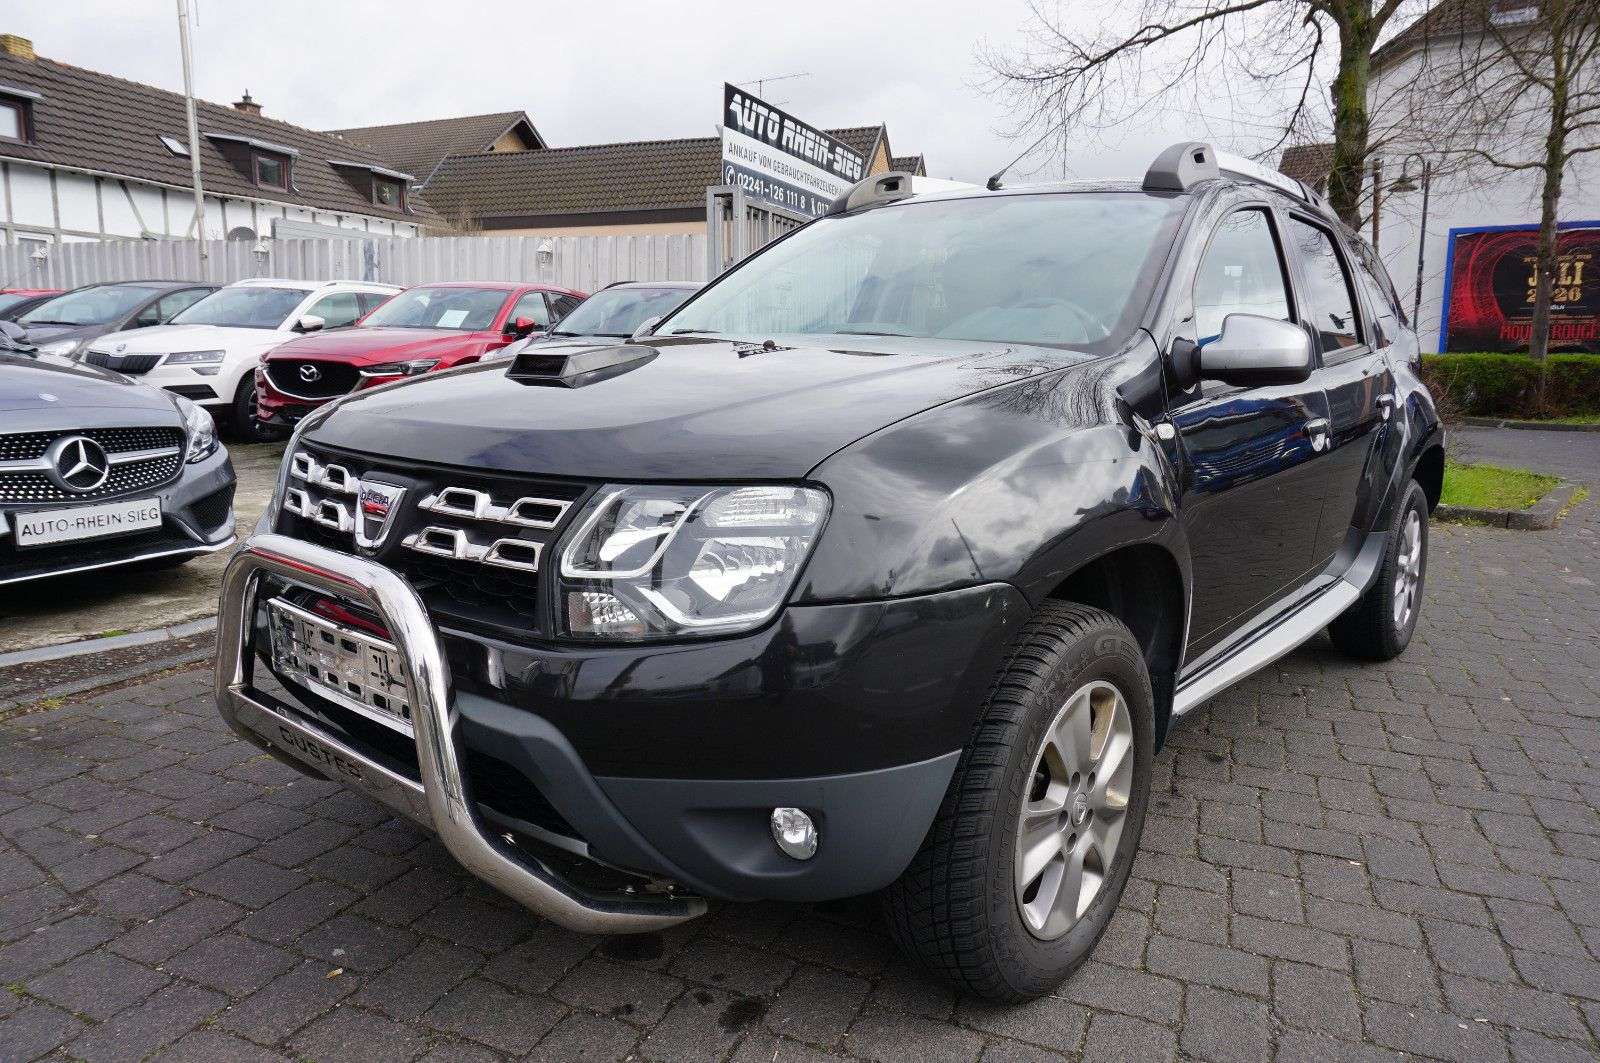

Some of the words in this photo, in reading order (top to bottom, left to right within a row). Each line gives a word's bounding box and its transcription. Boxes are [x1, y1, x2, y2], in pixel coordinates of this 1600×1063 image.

[729, 93, 780, 140] AUTO
[782, 118, 863, 181] RHEIN-SIEG
[728, 143, 757, 164] ANKAUF
[759, 154, 772, 172] VON
[737, 172, 784, 202] 02241-126
[786, 190, 798, 207] 111
[800, 195, 806, 209] 8
[1526, 287, 1582, 303] 220
